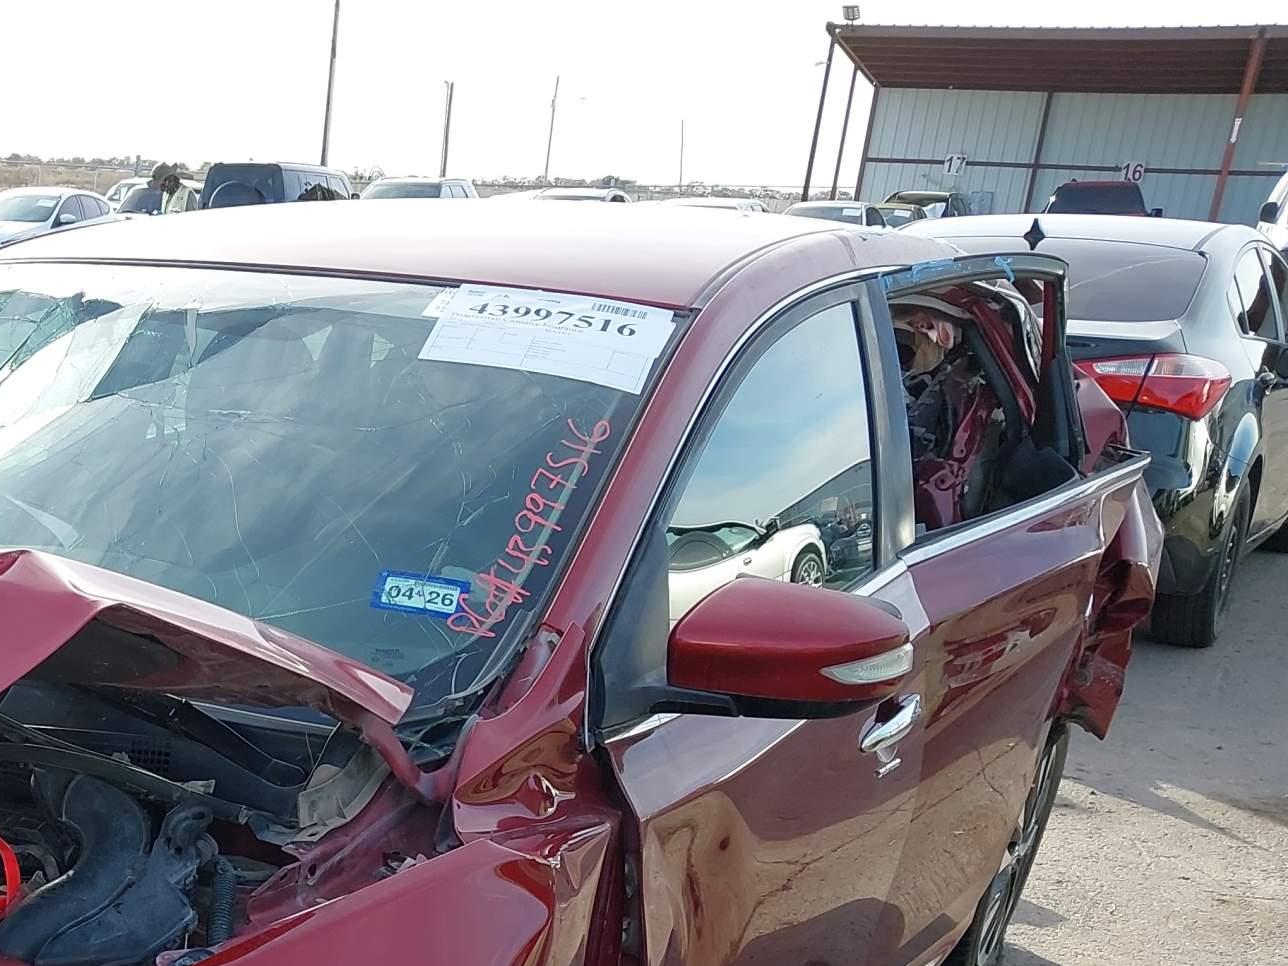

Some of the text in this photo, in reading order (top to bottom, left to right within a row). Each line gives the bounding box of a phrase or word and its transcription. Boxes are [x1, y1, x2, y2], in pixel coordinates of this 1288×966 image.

[946, 155, 967, 175] 17
[1122, 163, 1143, 182] 16
[468, 301, 637, 338] 43997516
[387, 584, 415, 602] 04
[426, 590, 455, 607] 26
